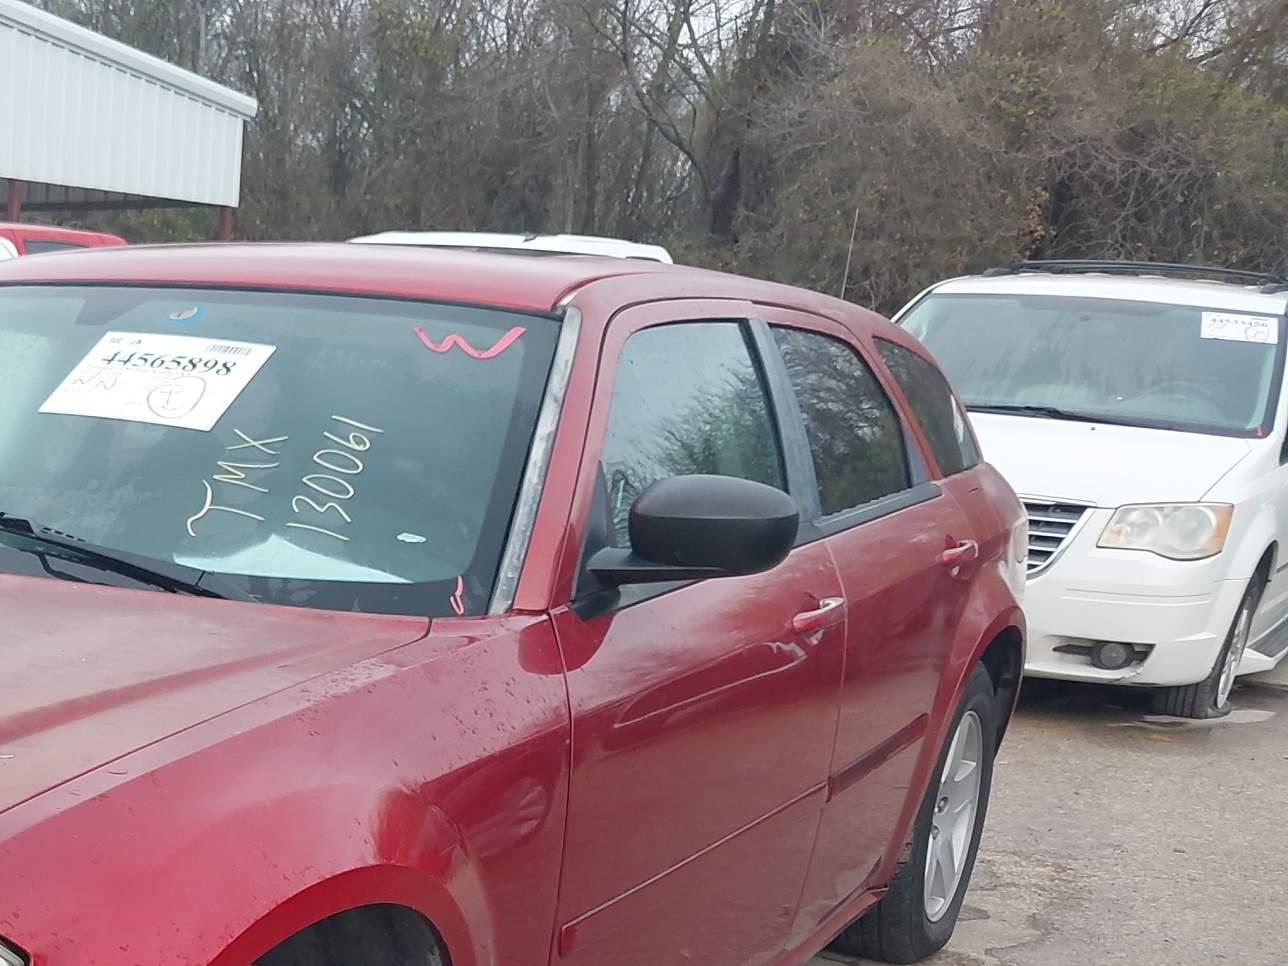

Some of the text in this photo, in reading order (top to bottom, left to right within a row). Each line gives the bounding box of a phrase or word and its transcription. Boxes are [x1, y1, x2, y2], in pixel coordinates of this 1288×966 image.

[101, 350, 237, 376] 44565898
[186, 427, 289, 537] TMX
[285, 414, 385, 541] 130061
